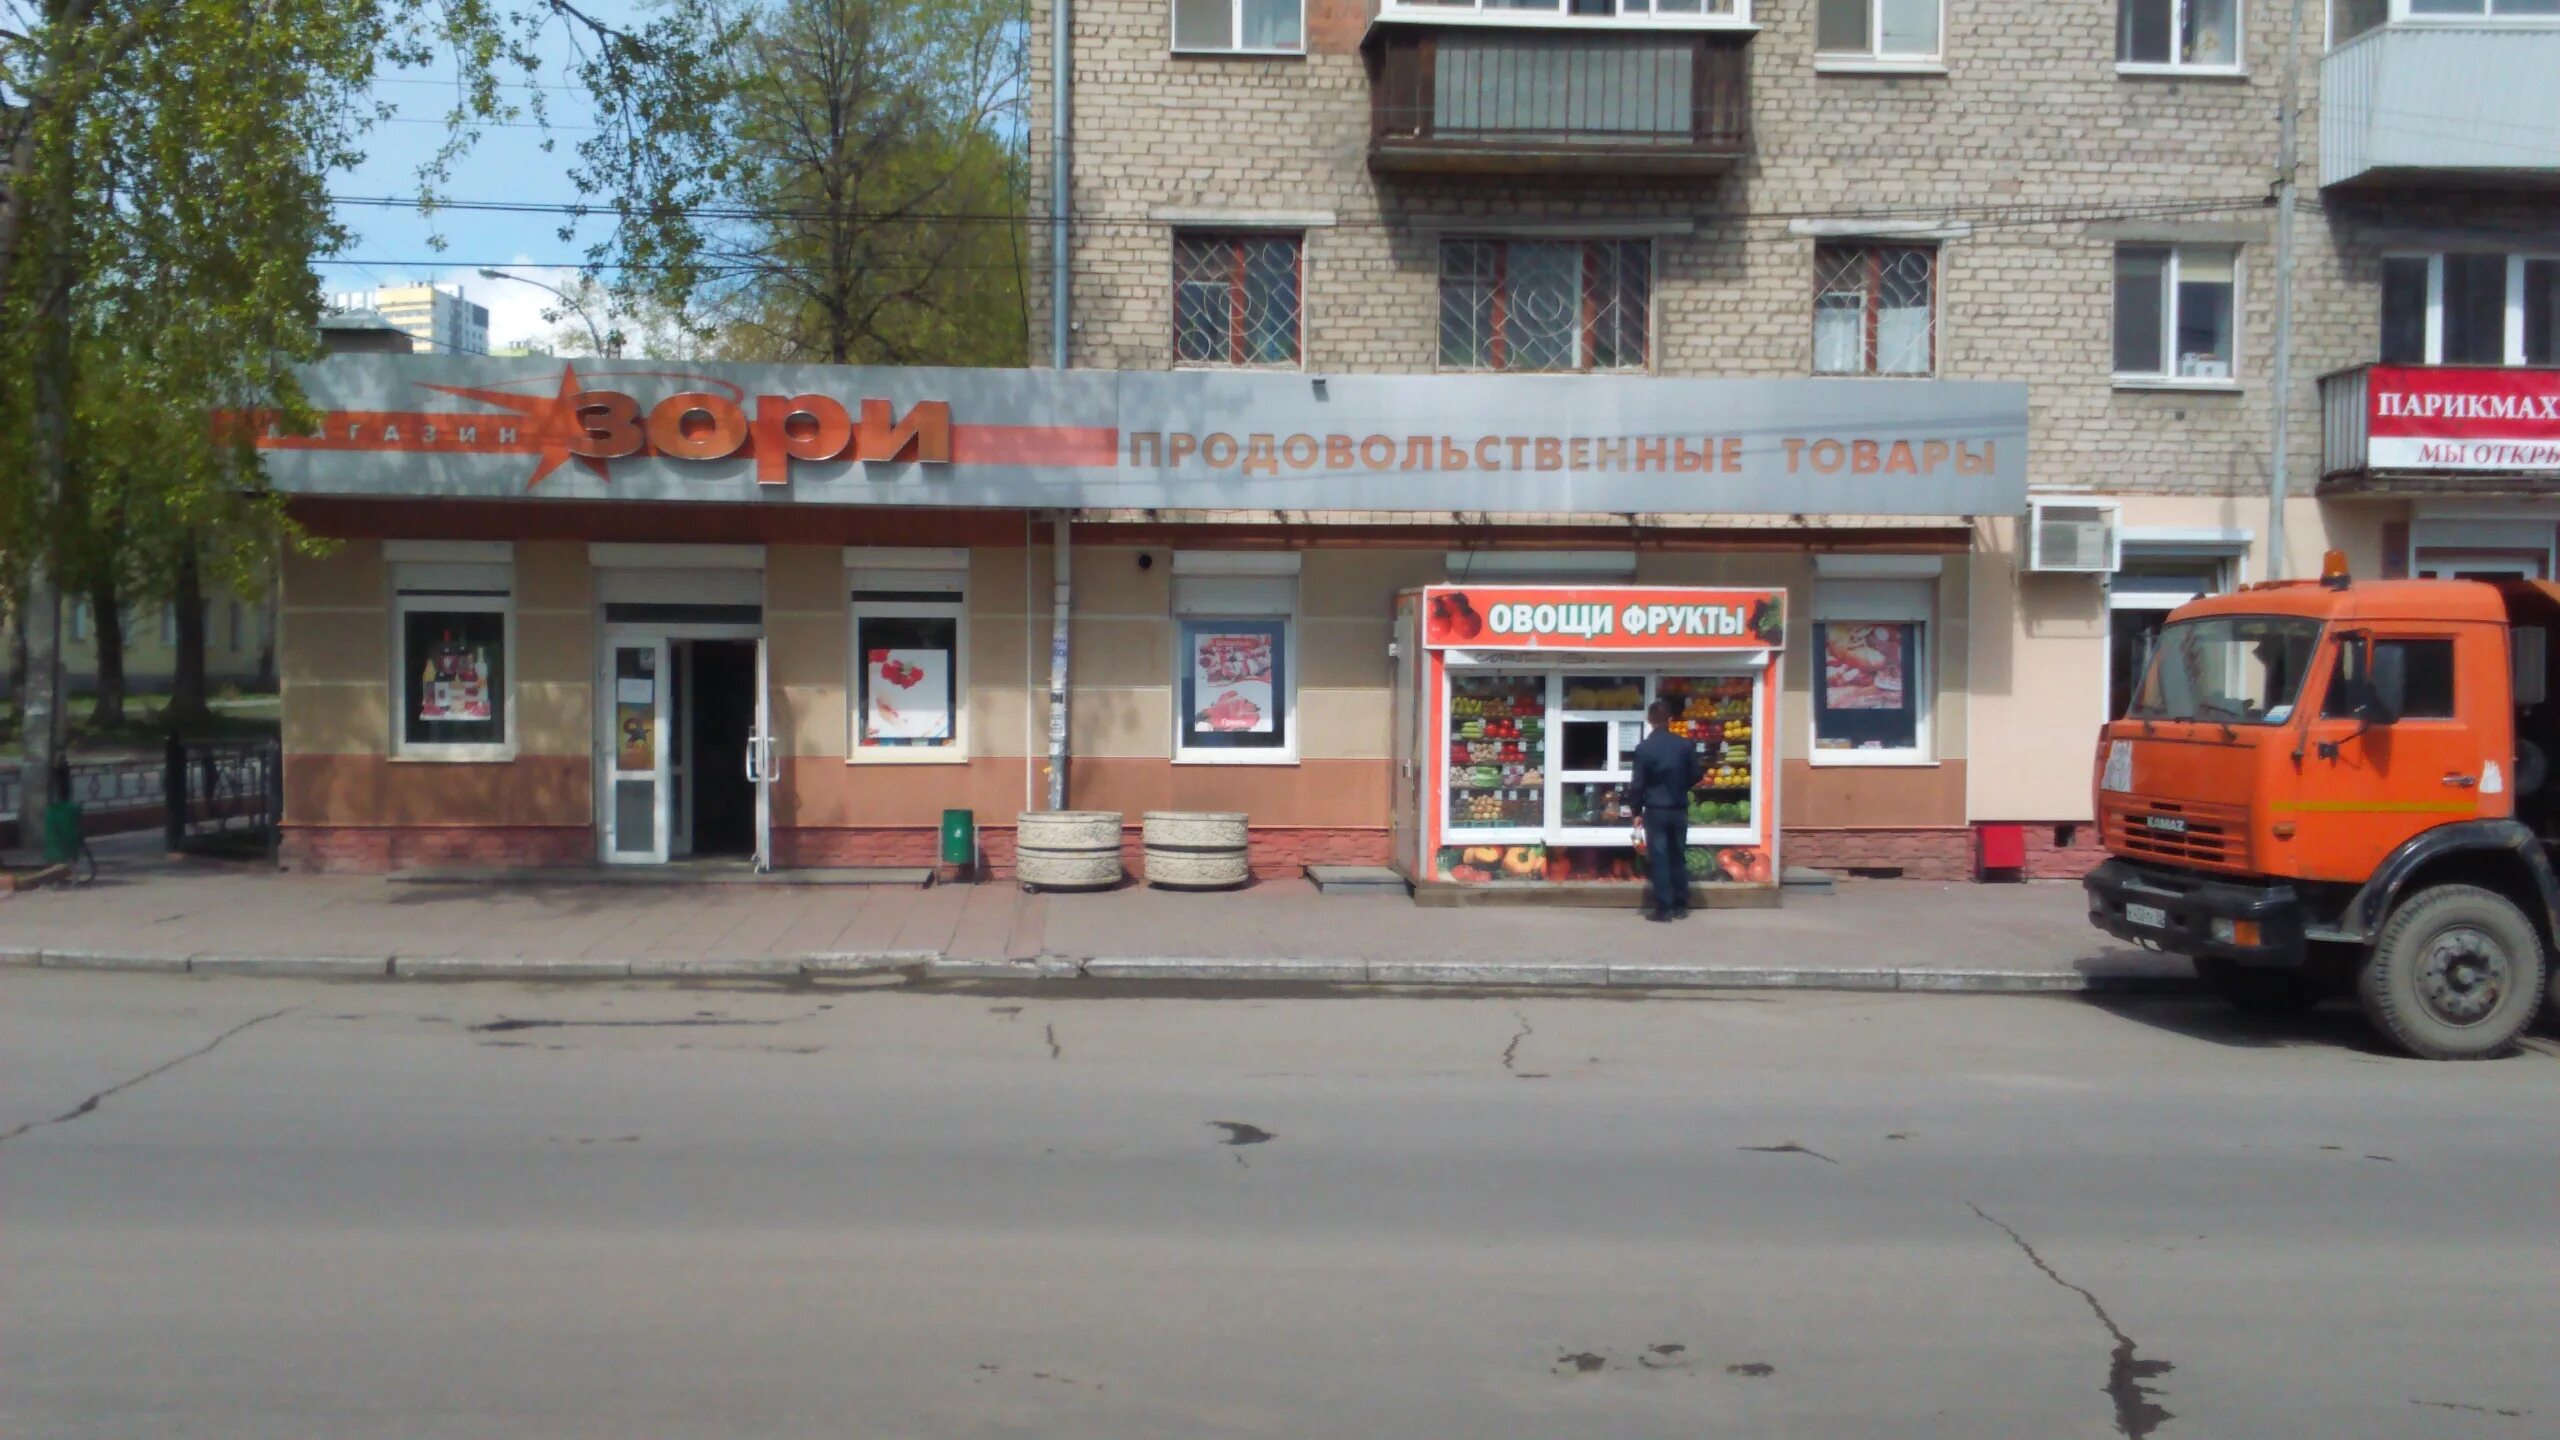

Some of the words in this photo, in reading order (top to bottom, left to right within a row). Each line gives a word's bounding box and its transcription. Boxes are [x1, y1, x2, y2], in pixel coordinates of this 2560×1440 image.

[1129, 432, 1743, 476] ПРОДОВОЛЬСТВЕННЫЕ
[1781, 438, 1998, 476] ТОВАРЫ
[2418, 444, 2466, 463] МЫ
[1488, 603, 1614, 639] ОВОЩИ
[1620, 604, 1745, 636] ФРУКТЫ
